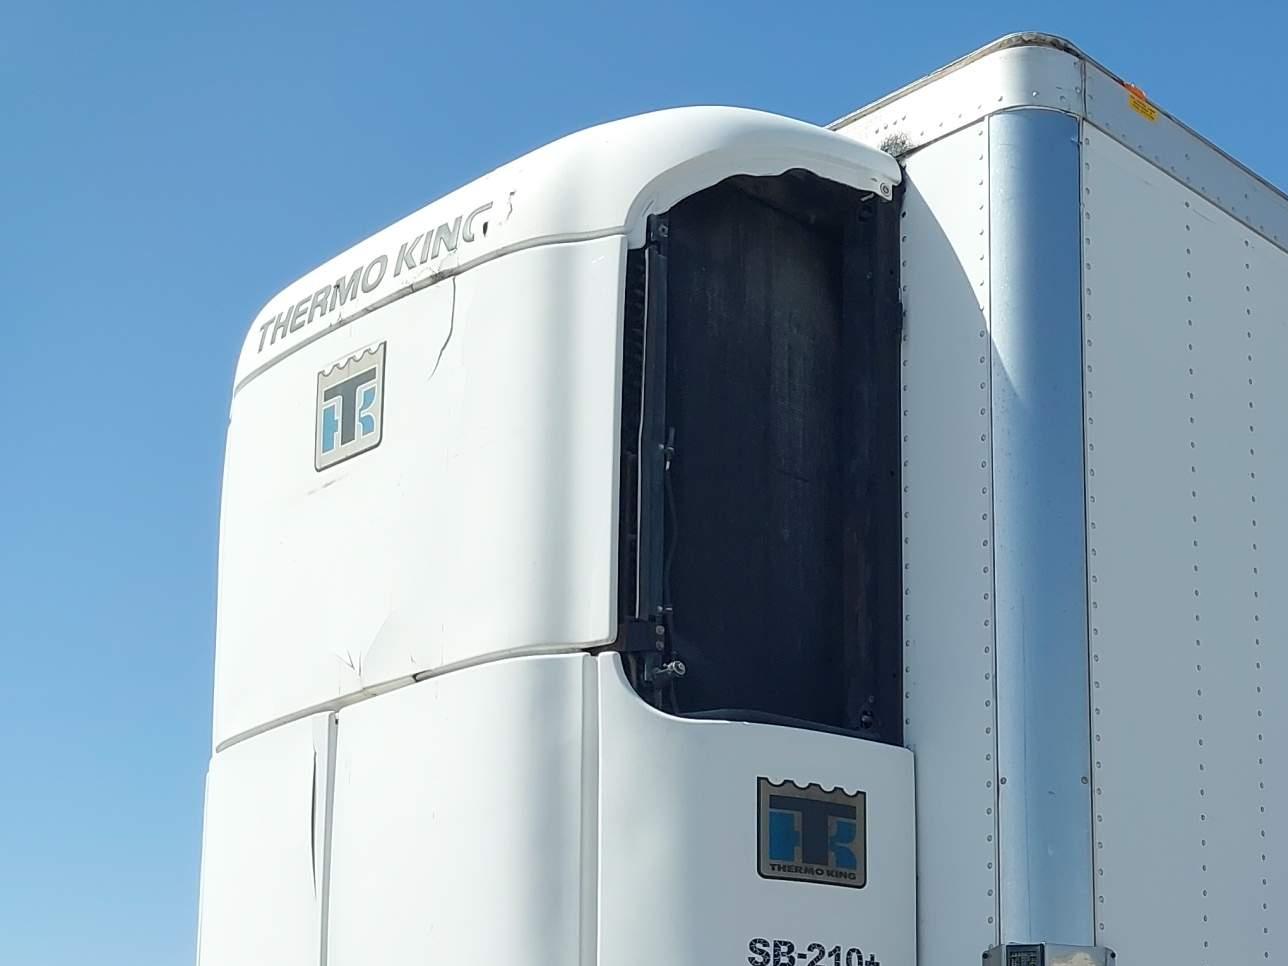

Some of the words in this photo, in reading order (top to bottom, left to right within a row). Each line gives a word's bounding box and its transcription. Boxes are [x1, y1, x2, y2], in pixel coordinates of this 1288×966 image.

[257, 254, 388, 353] THERMO
[769, 863, 825, 876] THERMO
[826, 869, 857, 880] KING
